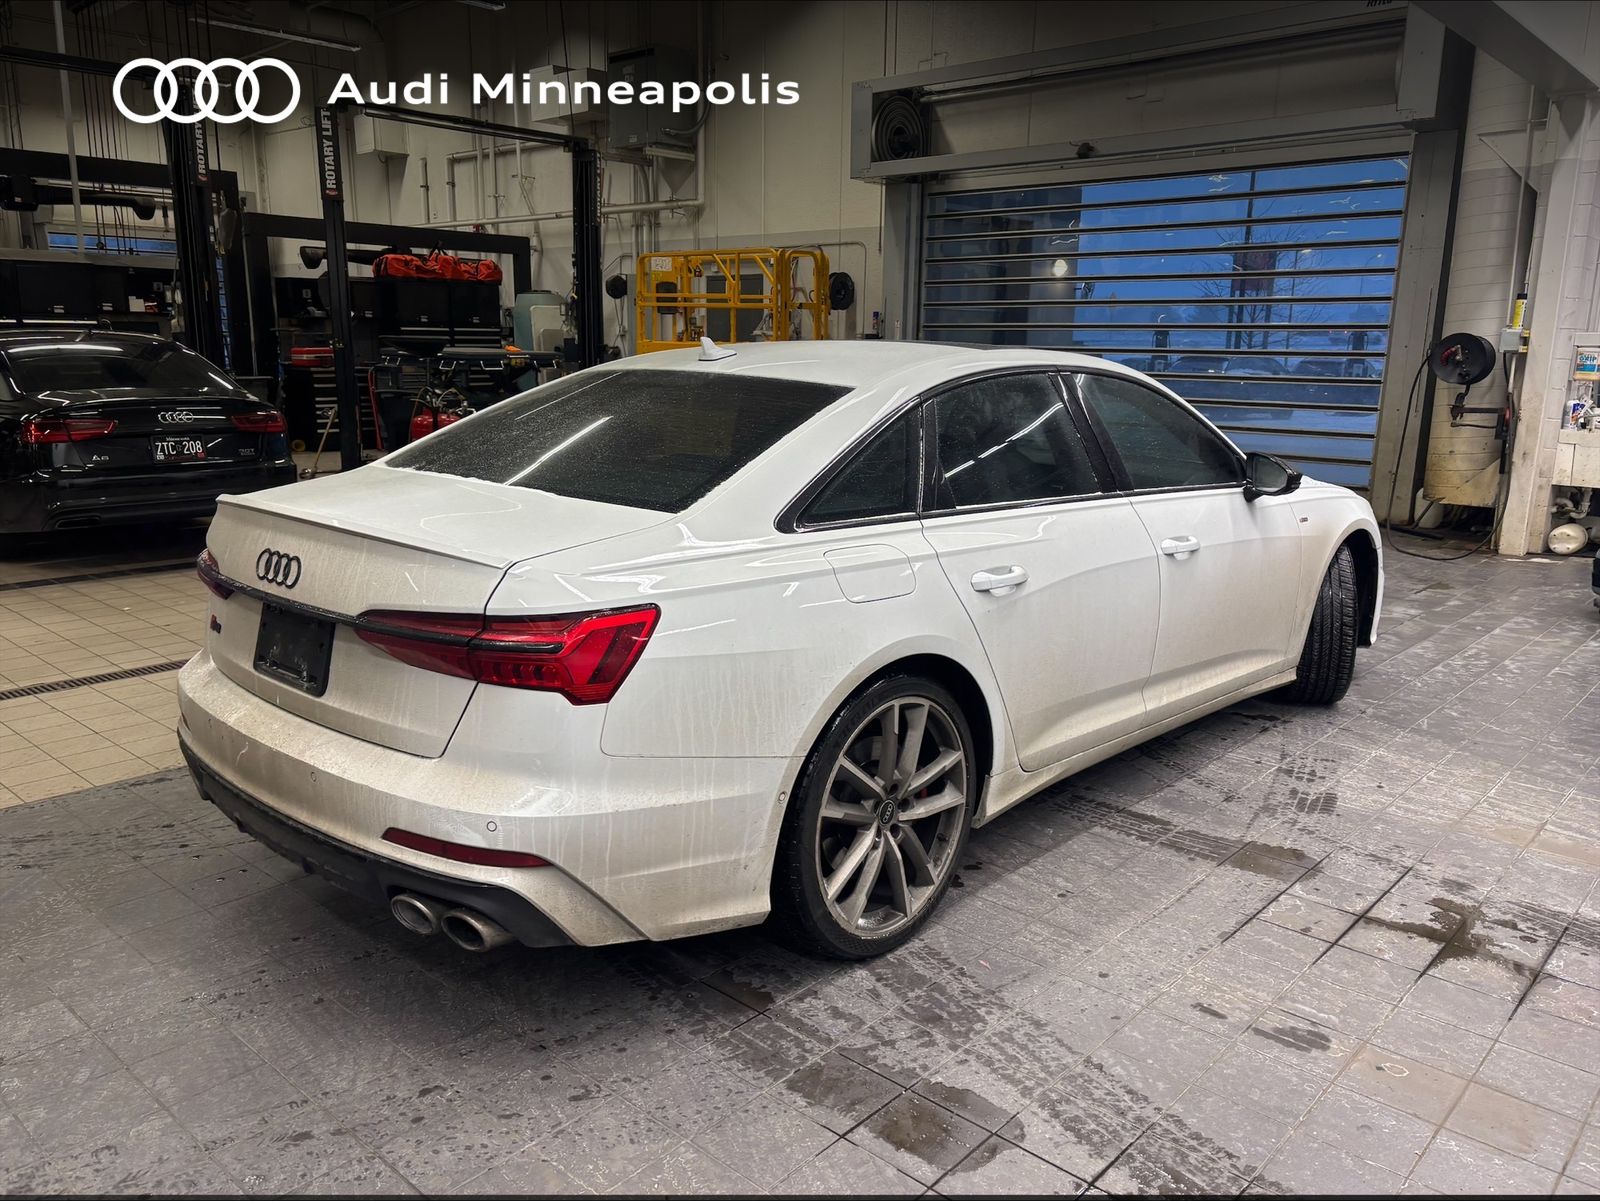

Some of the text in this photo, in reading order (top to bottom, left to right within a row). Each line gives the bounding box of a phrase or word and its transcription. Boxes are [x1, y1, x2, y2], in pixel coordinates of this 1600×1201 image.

[195, 121, 206, 174] ROTARY
[321, 109, 337, 189] ROTARY LIFT
[155, 440, 203, 455] ZTC 208
